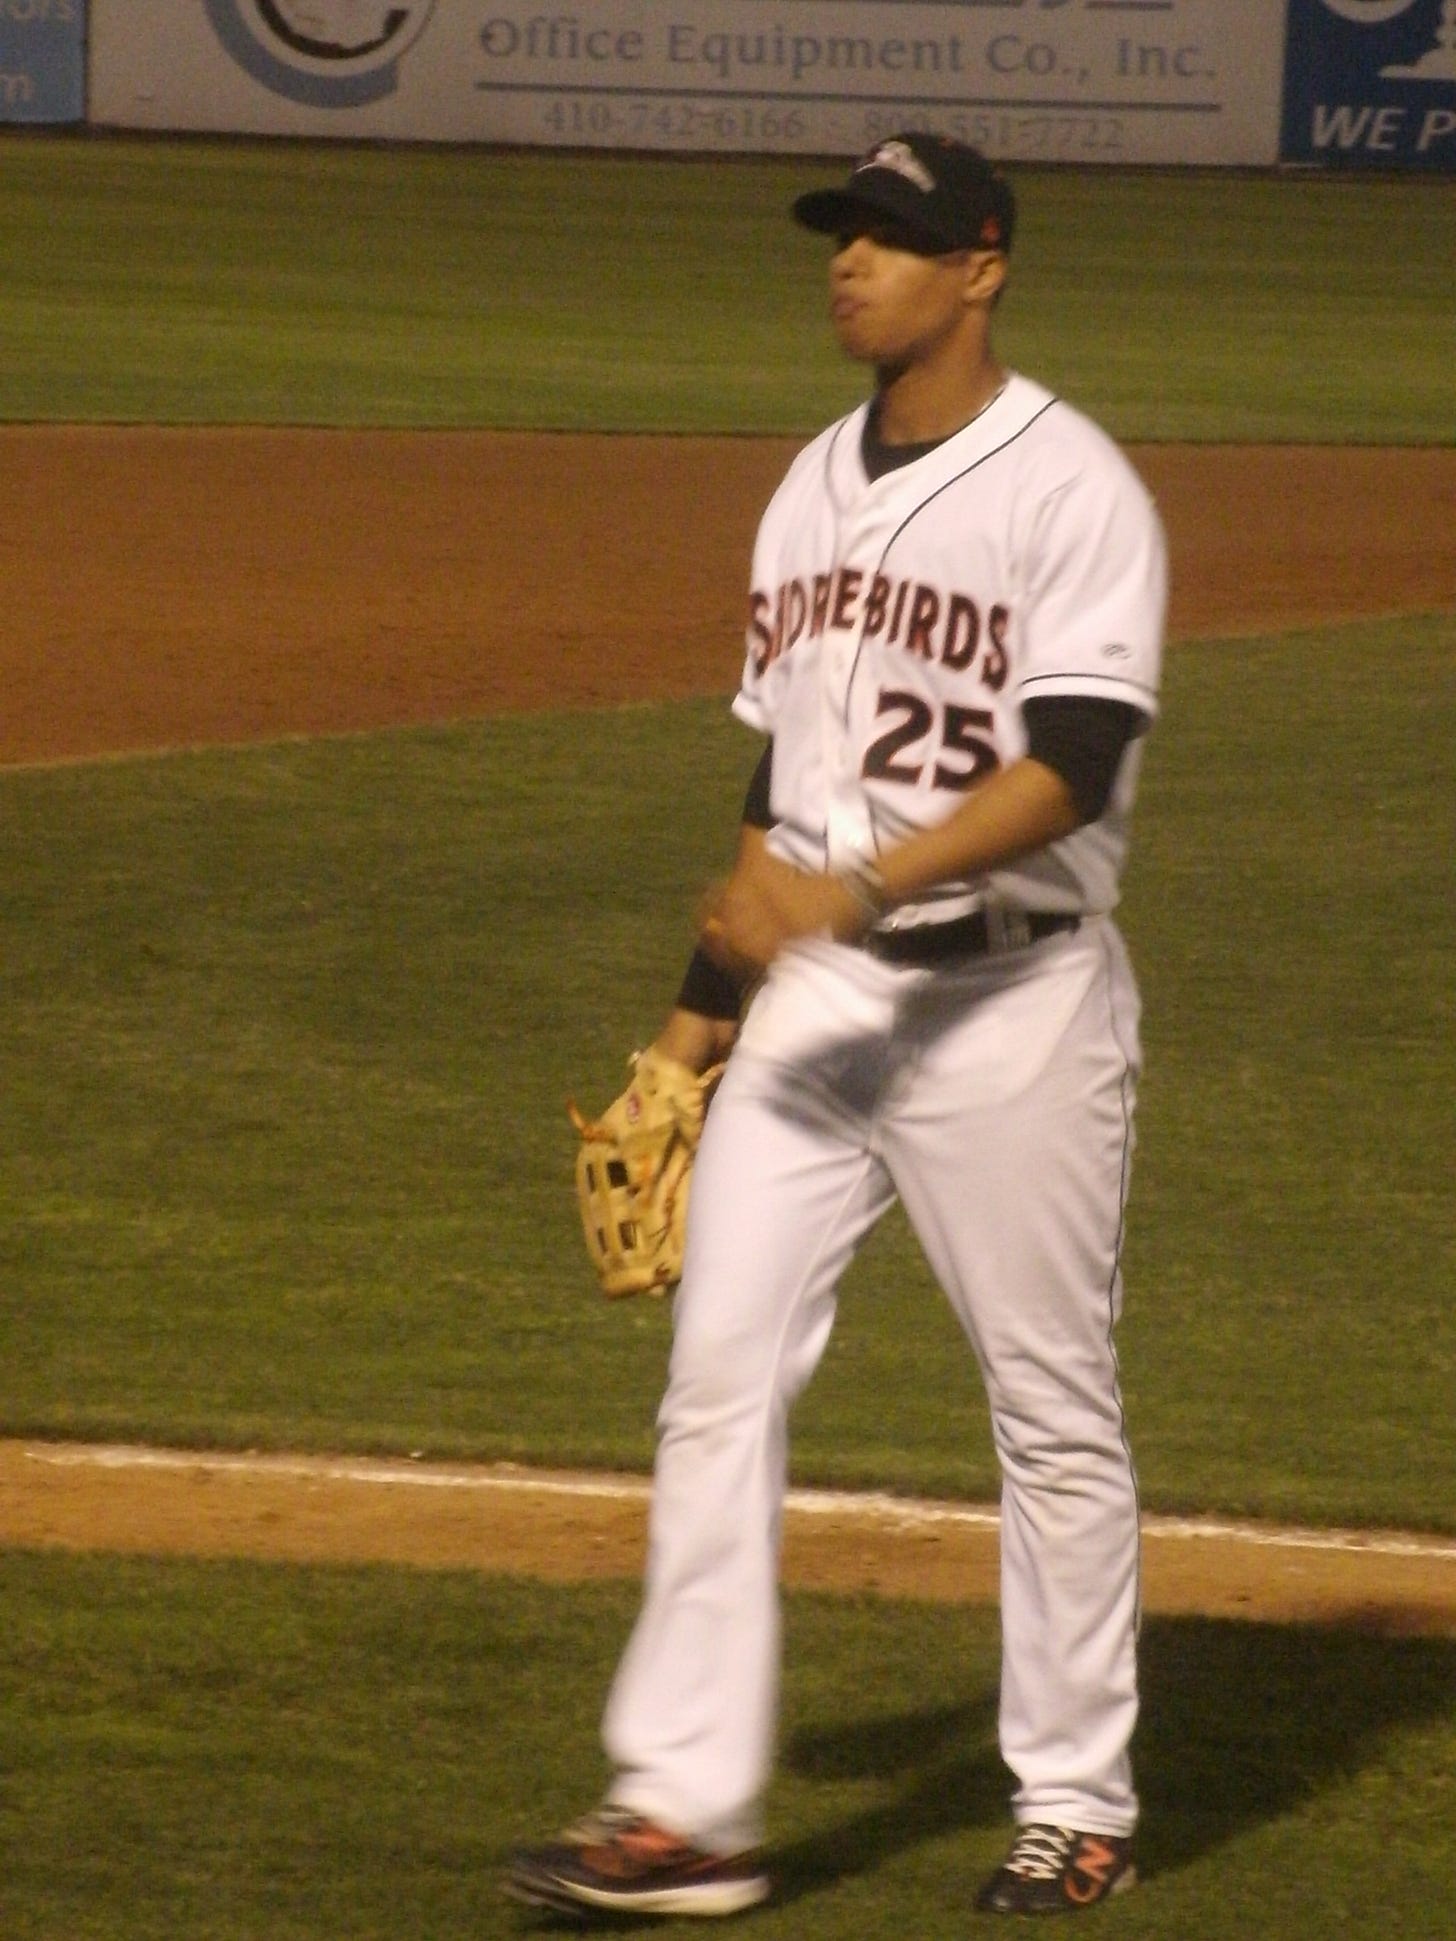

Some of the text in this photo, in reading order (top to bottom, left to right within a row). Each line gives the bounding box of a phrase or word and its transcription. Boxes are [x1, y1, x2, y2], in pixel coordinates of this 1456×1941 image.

[480, 16, 1217, 85] Office Equipment Co., Inc.
[546, 103, 804, 138] 410-742-6166
[1313, 106, 1405, 150] WE
[863, 693, 1000, 789] 25
